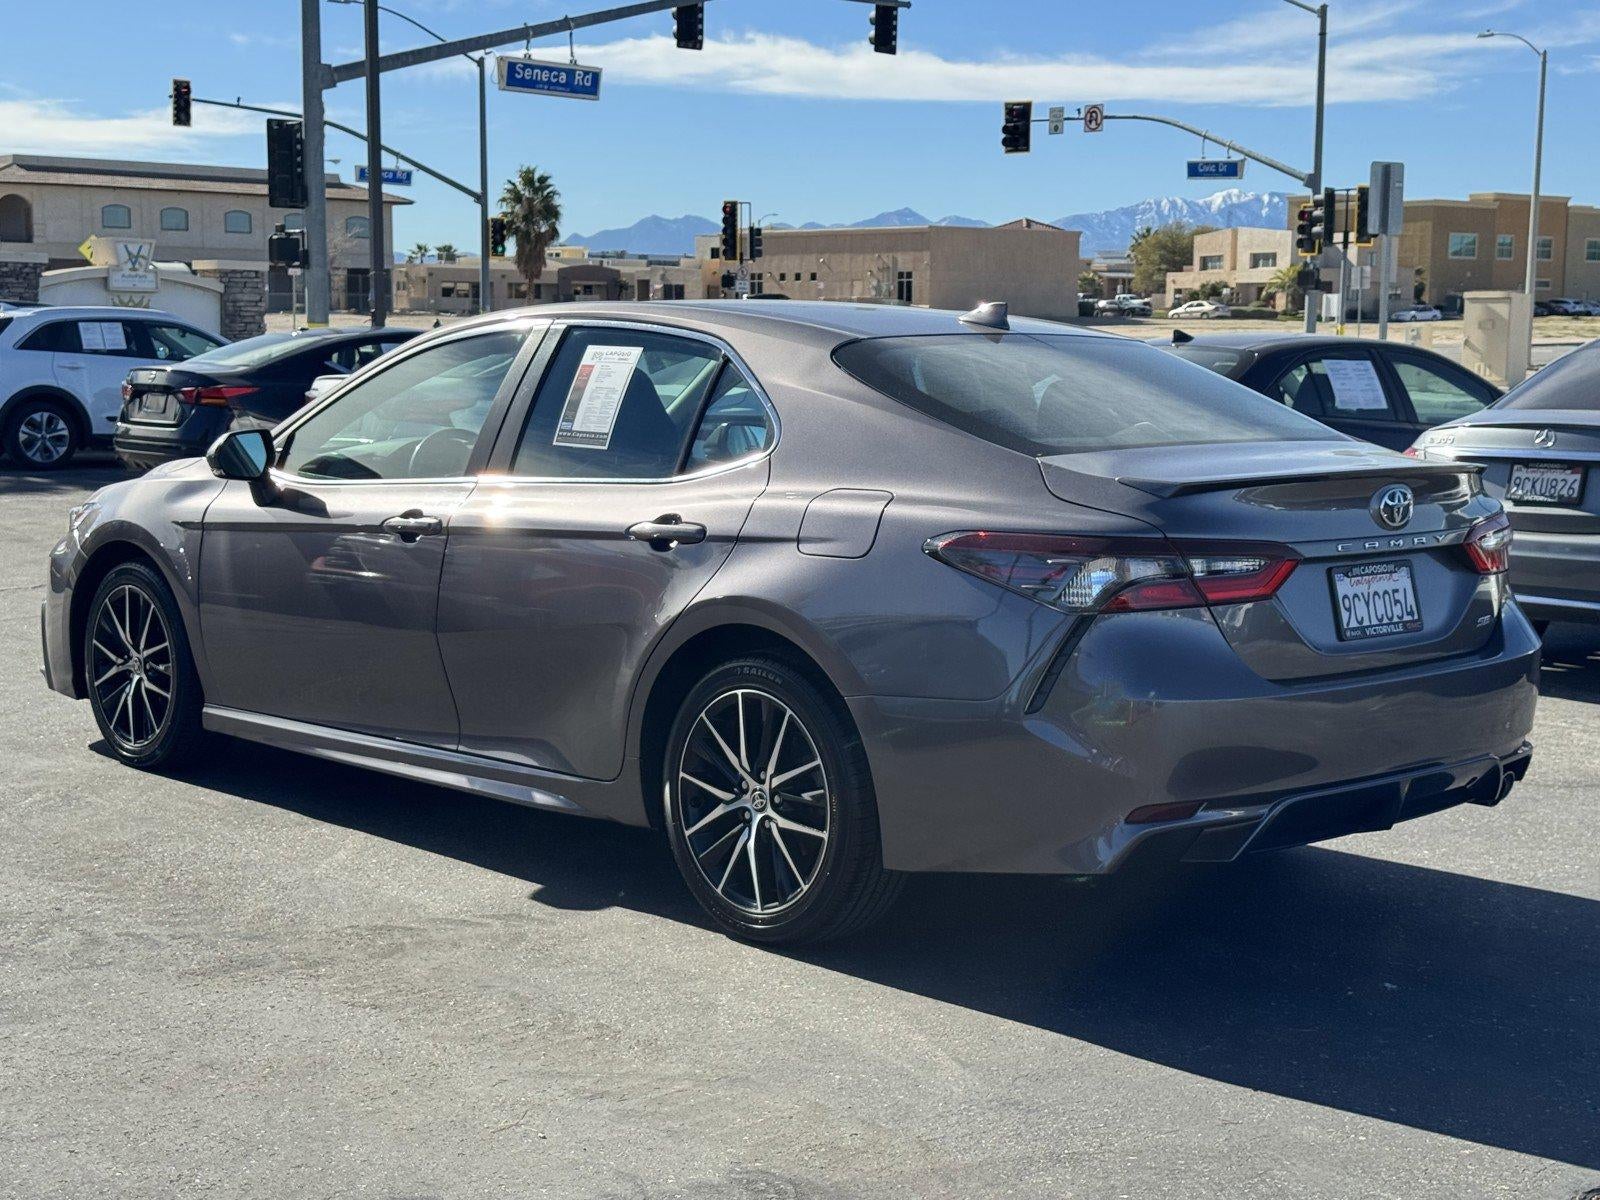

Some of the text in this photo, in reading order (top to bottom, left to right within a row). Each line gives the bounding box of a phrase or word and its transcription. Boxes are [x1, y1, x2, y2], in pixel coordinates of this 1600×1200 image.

[514, 63, 567, 84] Seneca
[574, 70, 593, 87] Rd
[1198, 162, 1228, 173] Civic Dr
[1513, 476, 1578, 498] 9CKU826
[1336, 534, 1446, 551] CAMRY
[1360, 564, 1388, 575] CAPOSIO
[1341, 587, 1416, 629] 9CYC054
[1365, 623, 1404, 636] VICTORVILLE
